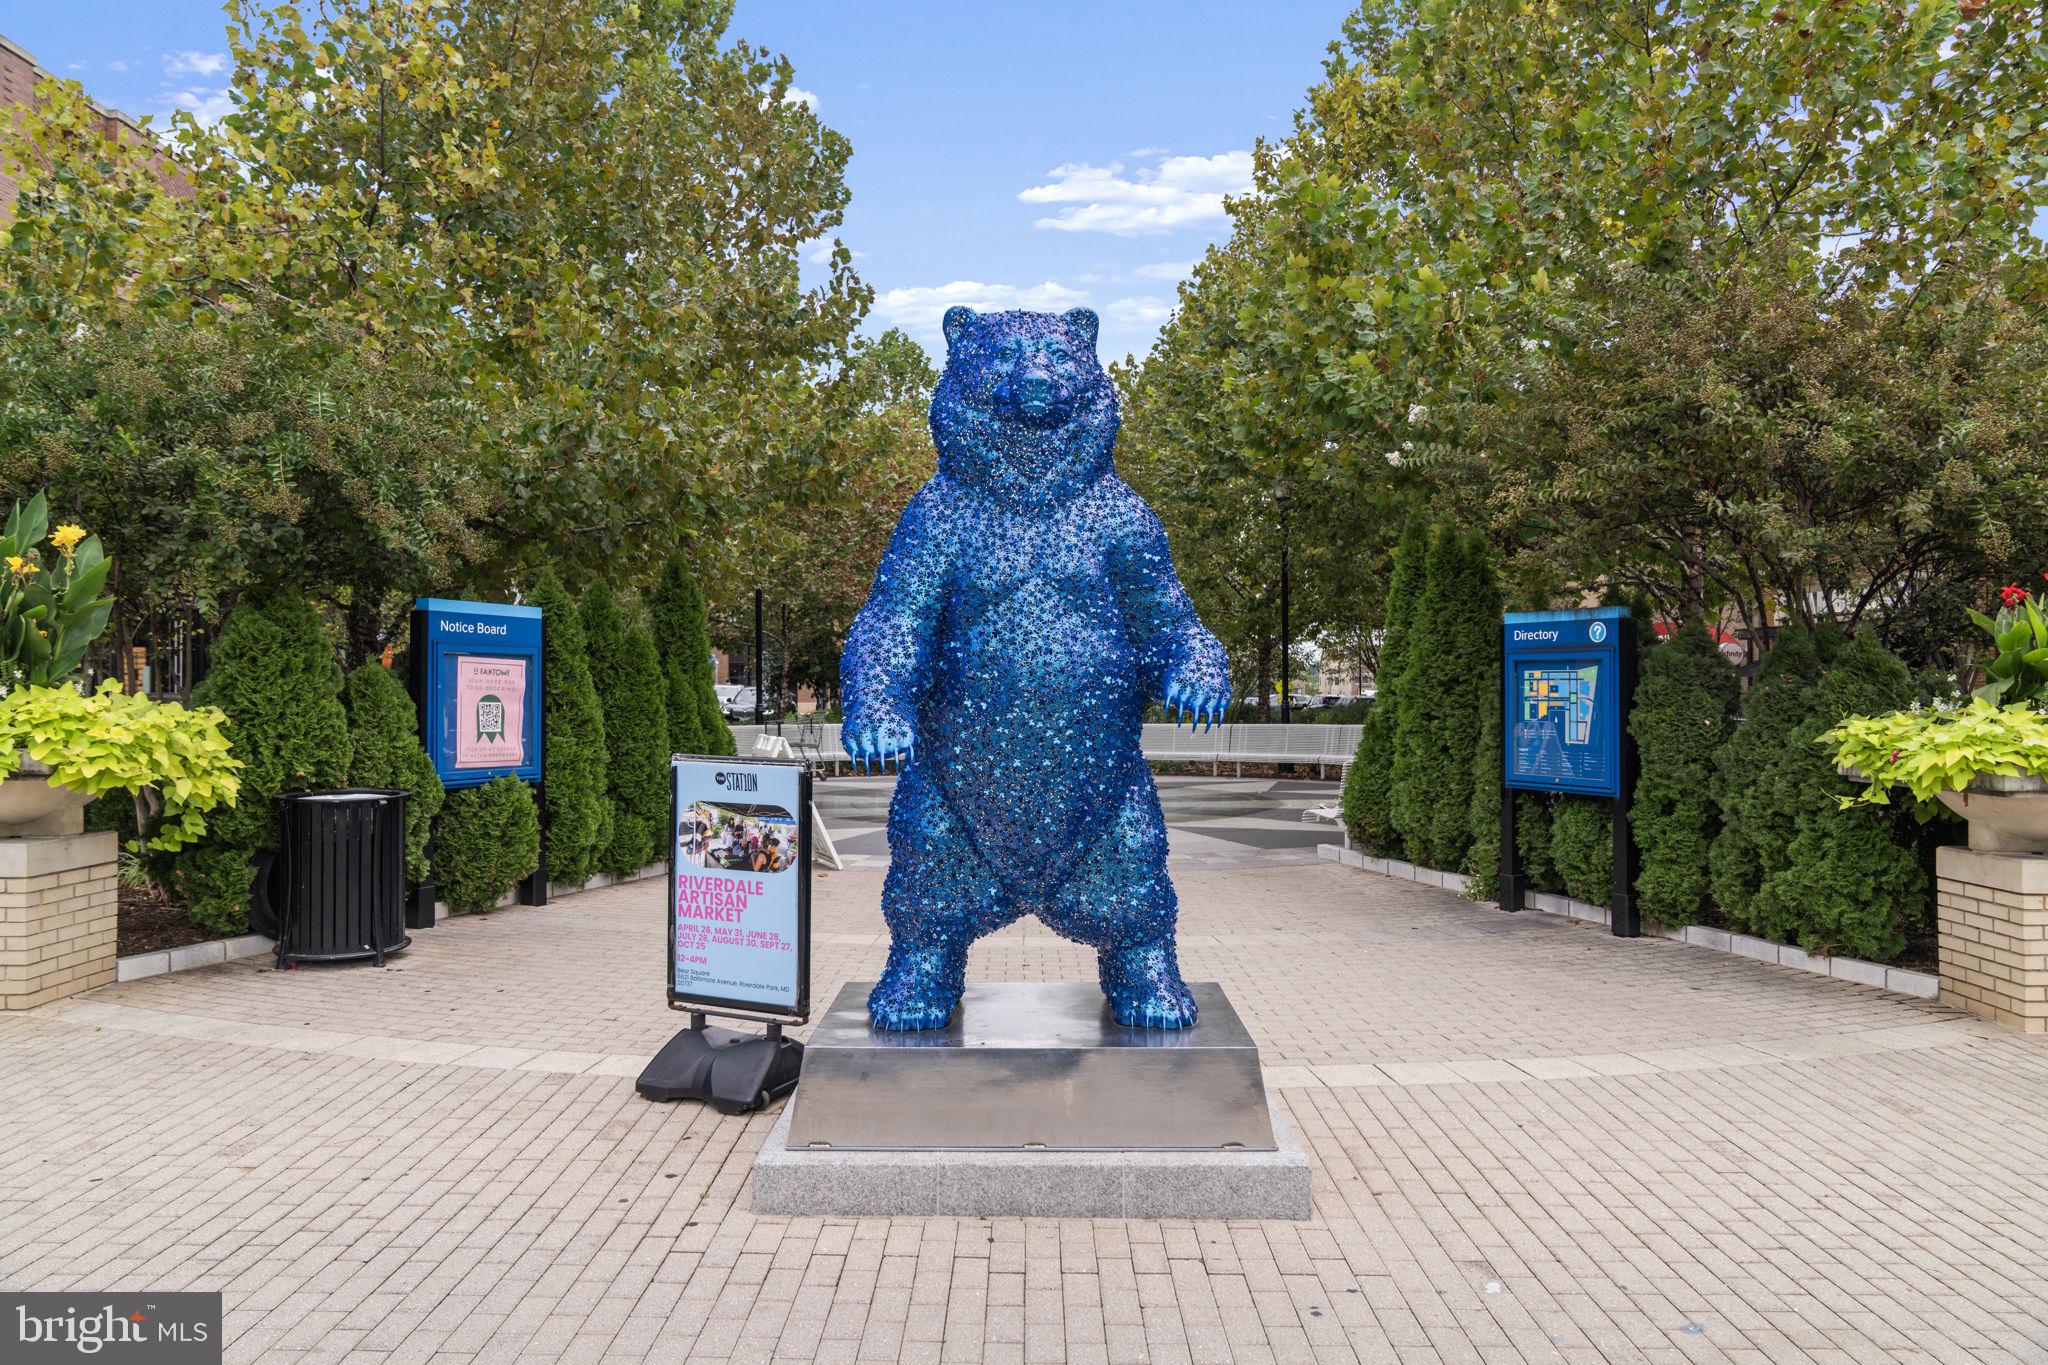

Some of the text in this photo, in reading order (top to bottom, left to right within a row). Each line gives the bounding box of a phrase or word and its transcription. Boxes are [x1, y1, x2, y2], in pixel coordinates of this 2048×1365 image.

[440, 620, 507, 635] Notice Board
[1514, 629, 1559, 642] Directory
[480, 668, 510, 676] FANTOME
[678, 875, 764, 896] RIVERDALE
[678, 890, 747, 909] ARTISAN
[678, 904, 743, 923] MARKET
[678, 924, 699, 933] APRIL
[715, 927, 732, 936] MAY
[735, 929, 744, 938] 31,
[747, 930, 767, 940] JUNE
[769, 932, 781, 942] 28,
[678, 932, 792, 952] JULY 26, AUGUST 30, SEPT 27,
[677, 940, 706, 950] OCT 25
[677, 954, 707, 965] 12-4PM
[690, 975, 716, 984] Baltimore
[717, 978, 738, 987] Avenue,
[739, 980, 765, 990] Riverdale
[766, 984, 779, 992] Park,
[780, 985, 790, 993] MD
